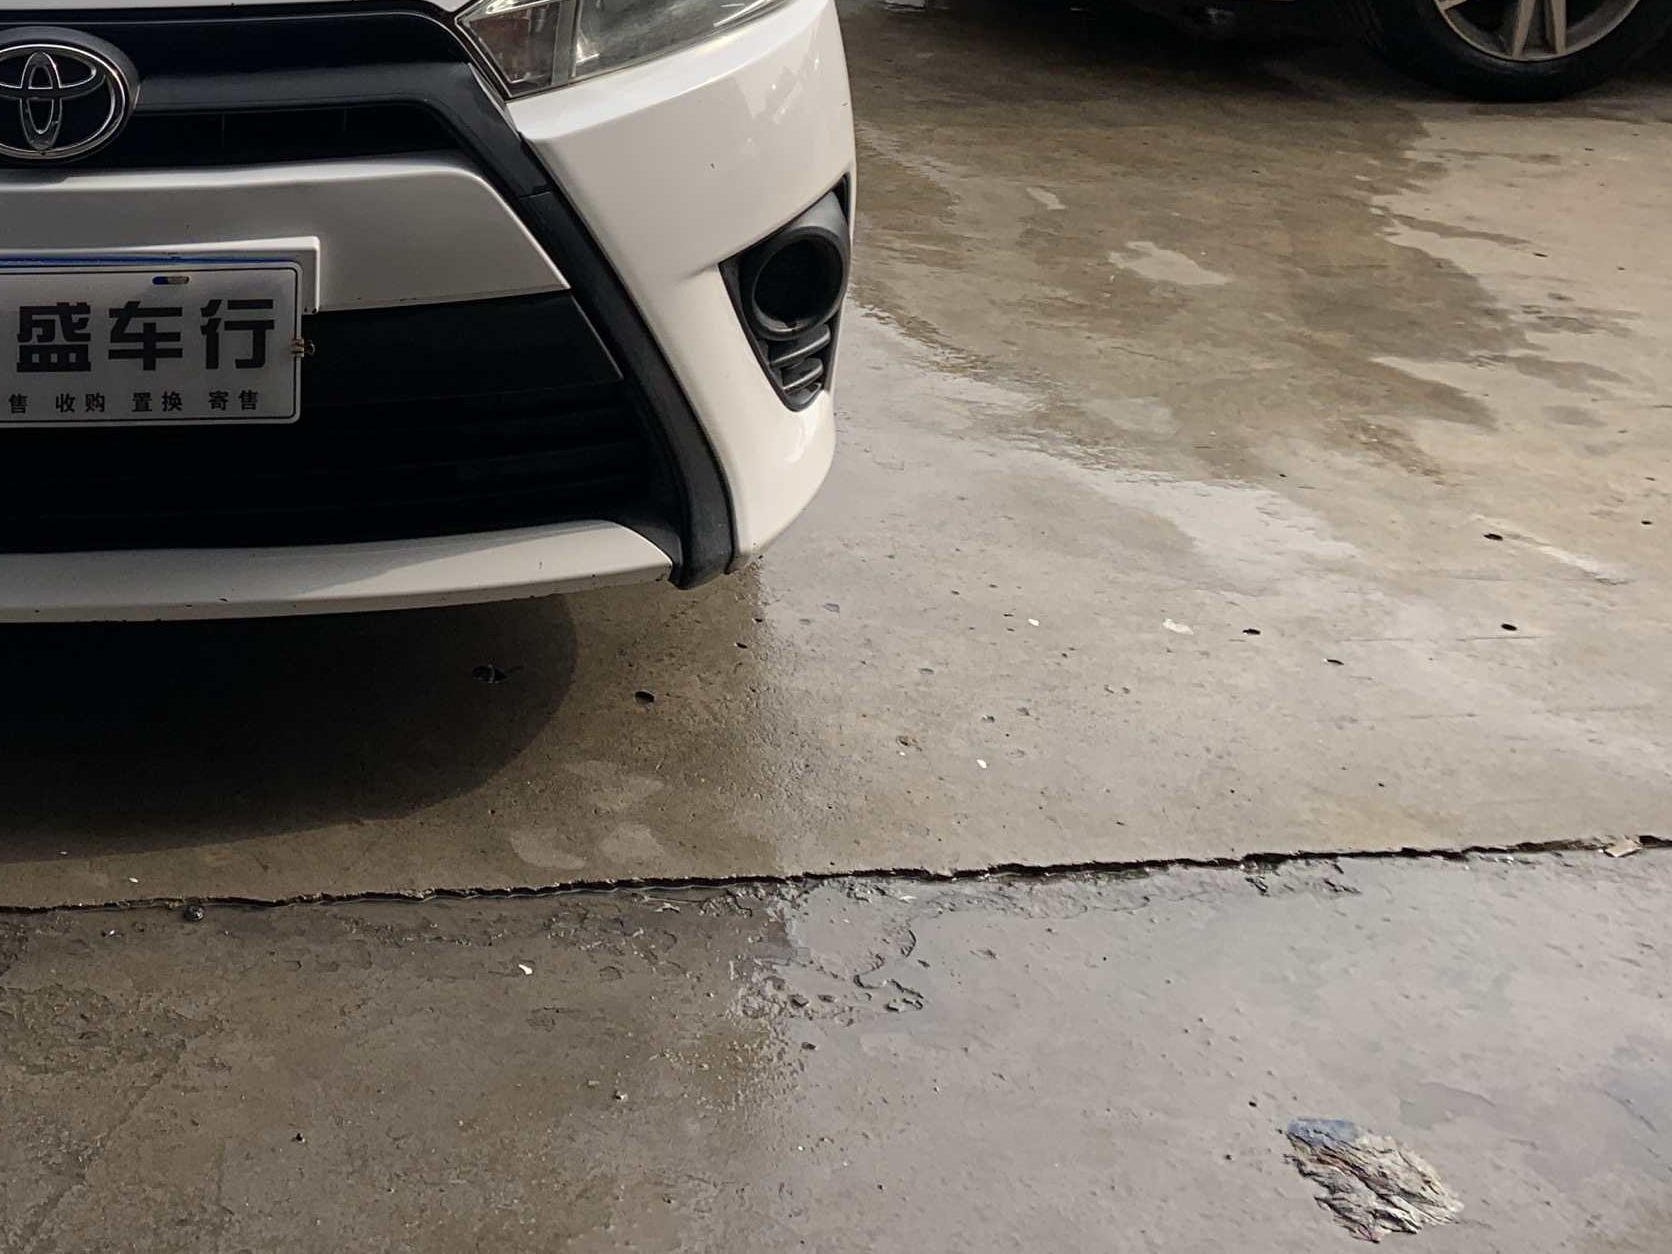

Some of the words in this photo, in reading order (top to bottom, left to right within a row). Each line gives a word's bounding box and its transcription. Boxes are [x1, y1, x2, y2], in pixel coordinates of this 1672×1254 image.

[55, 392, 106, 413] 收购
[131, 391, 184, 413] 置换
[208, 389, 259, 411] 寄售
